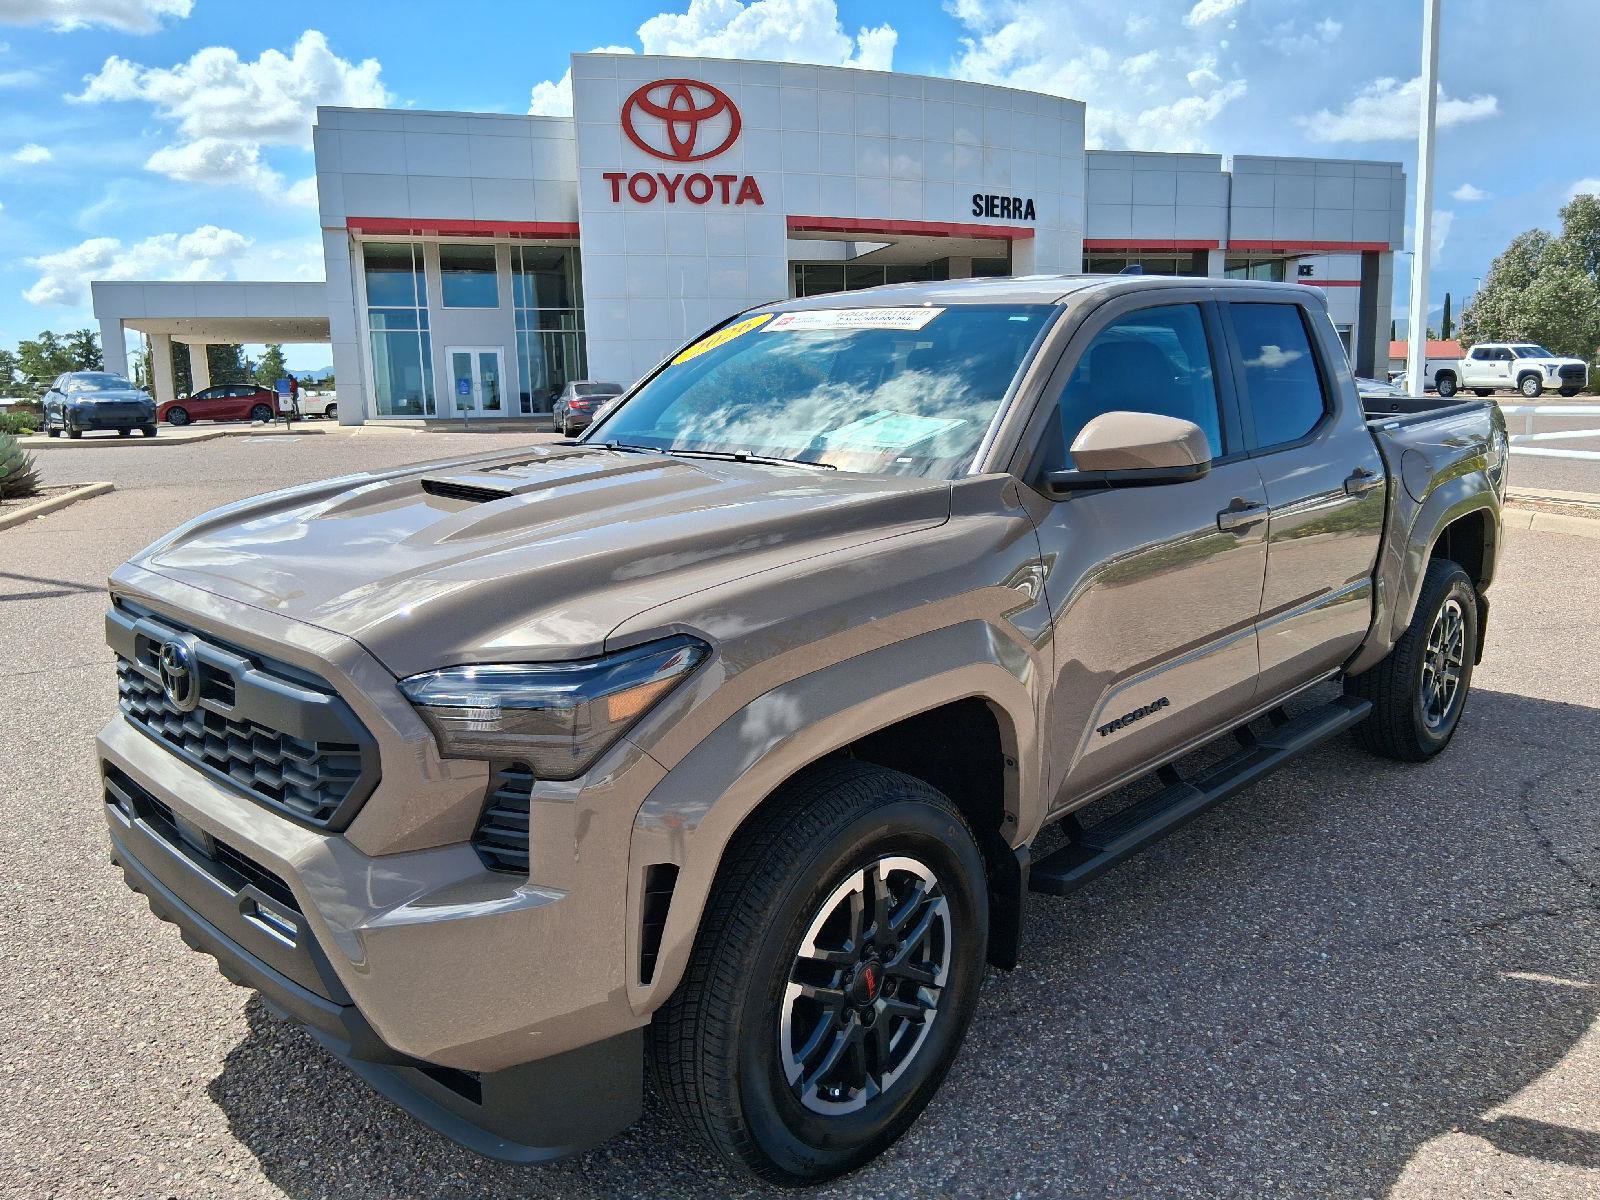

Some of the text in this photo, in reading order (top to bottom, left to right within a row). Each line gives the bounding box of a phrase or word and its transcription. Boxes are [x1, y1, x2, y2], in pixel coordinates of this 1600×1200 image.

[602, 172, 765, 205] TOYOTA
[972, 193, 1036, 221] SIERRA
[1096, 696, 1170, 737] TACOMA
